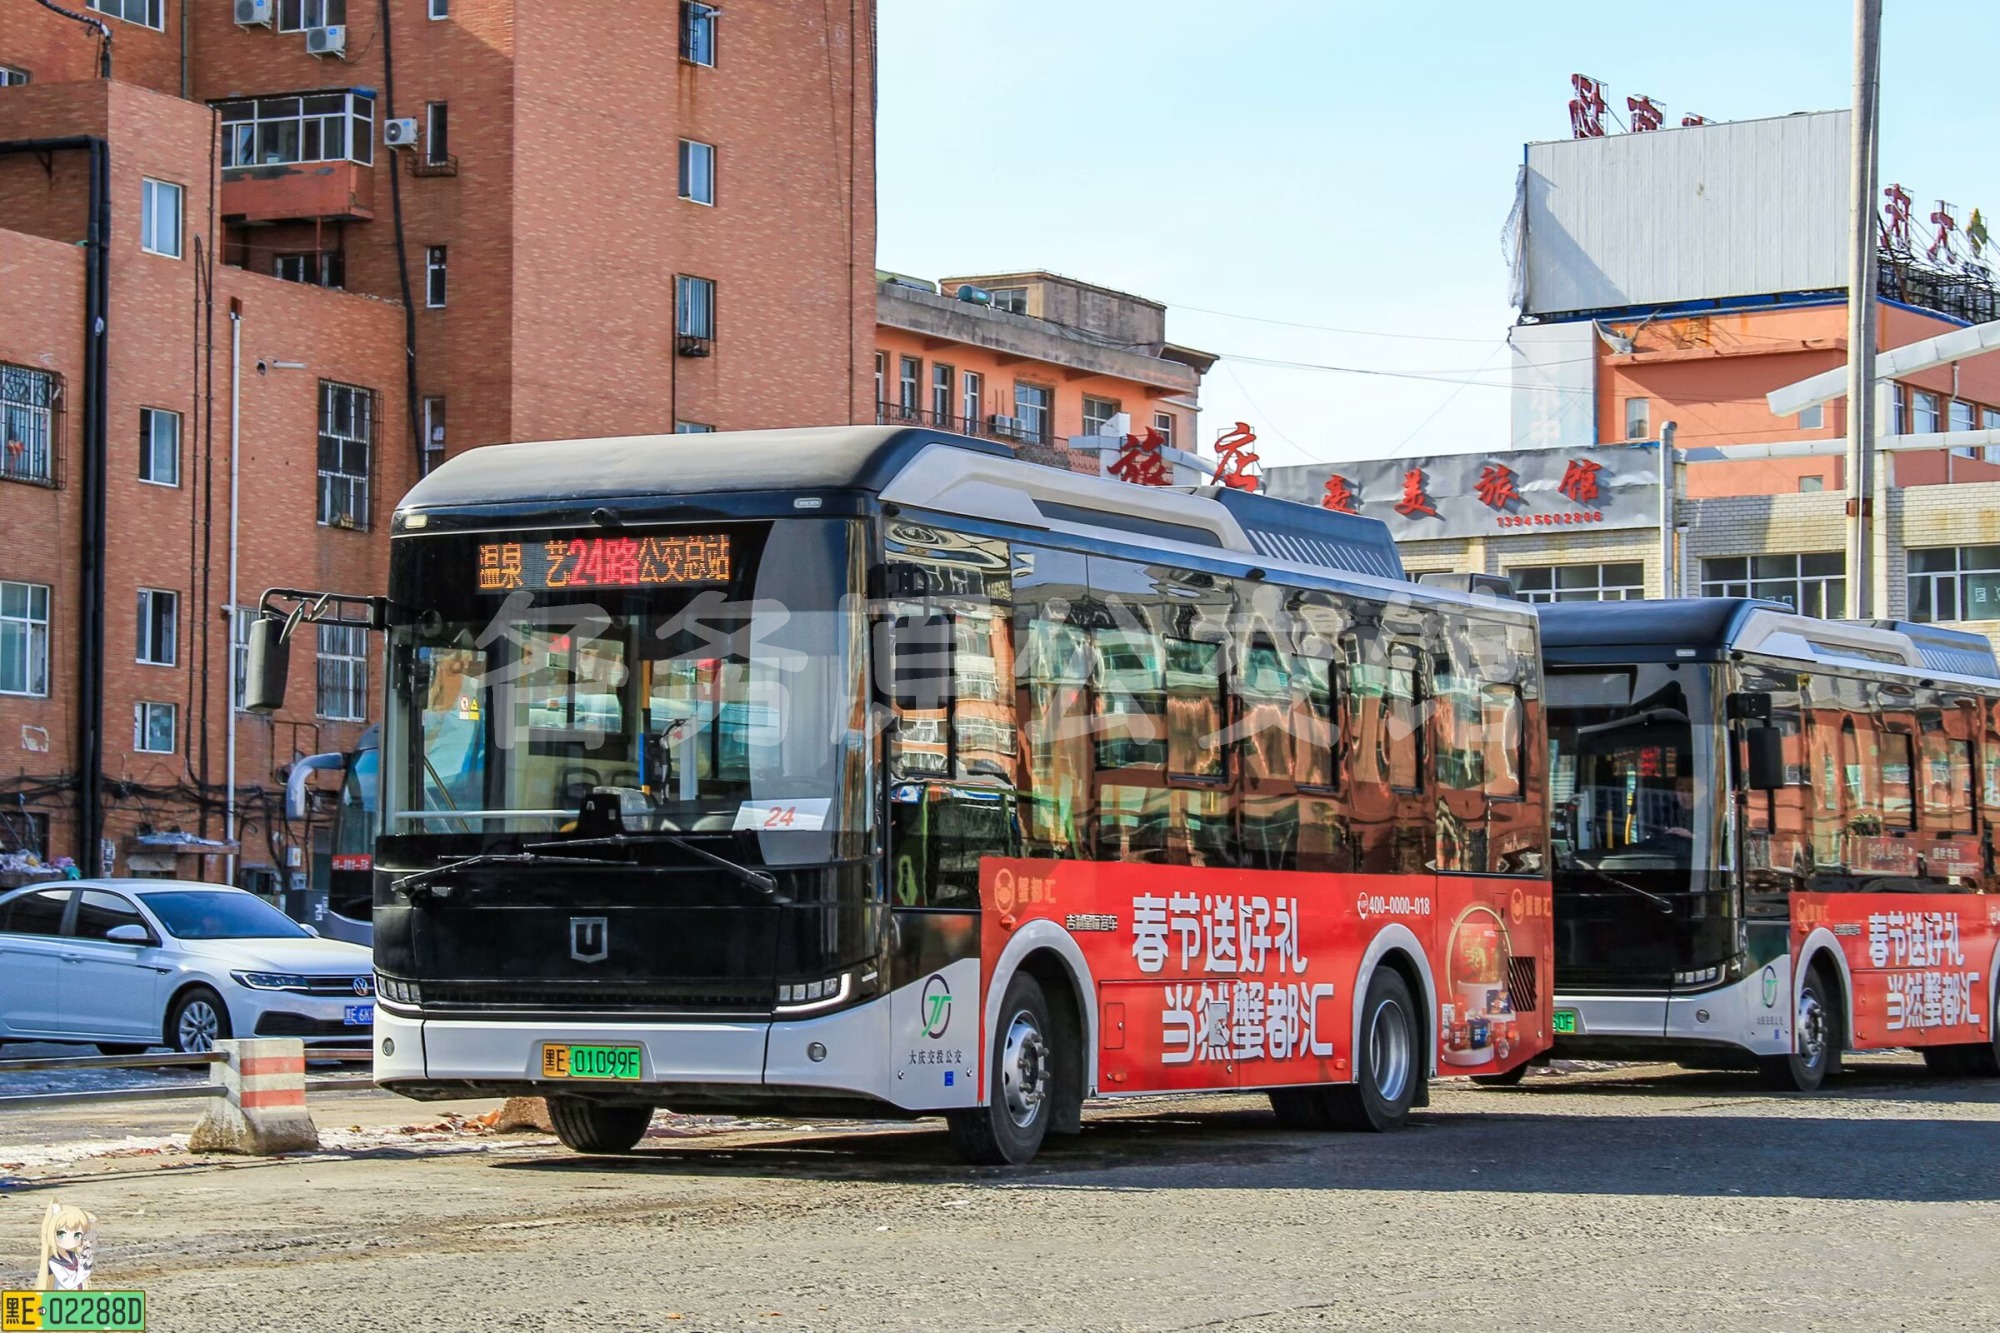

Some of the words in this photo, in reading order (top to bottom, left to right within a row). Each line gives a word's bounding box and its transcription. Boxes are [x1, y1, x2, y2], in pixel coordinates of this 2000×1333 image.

[480, 543, 523, 589] 温泉
[764, 806, 796, 827] 24
[1369, 896, 1430, 915] 400-0000-018
[1132, 892, 1308, 974] 春节送好礼
[1868, 911, 1965, 967] 春节送好礼
[1161, 981, 1334, 1063] 当然蟹都汇
[1886, 971, 1980, 1030] 当然蟹都汇
[909, 1049, 962, 1065] 大庆交投公交
